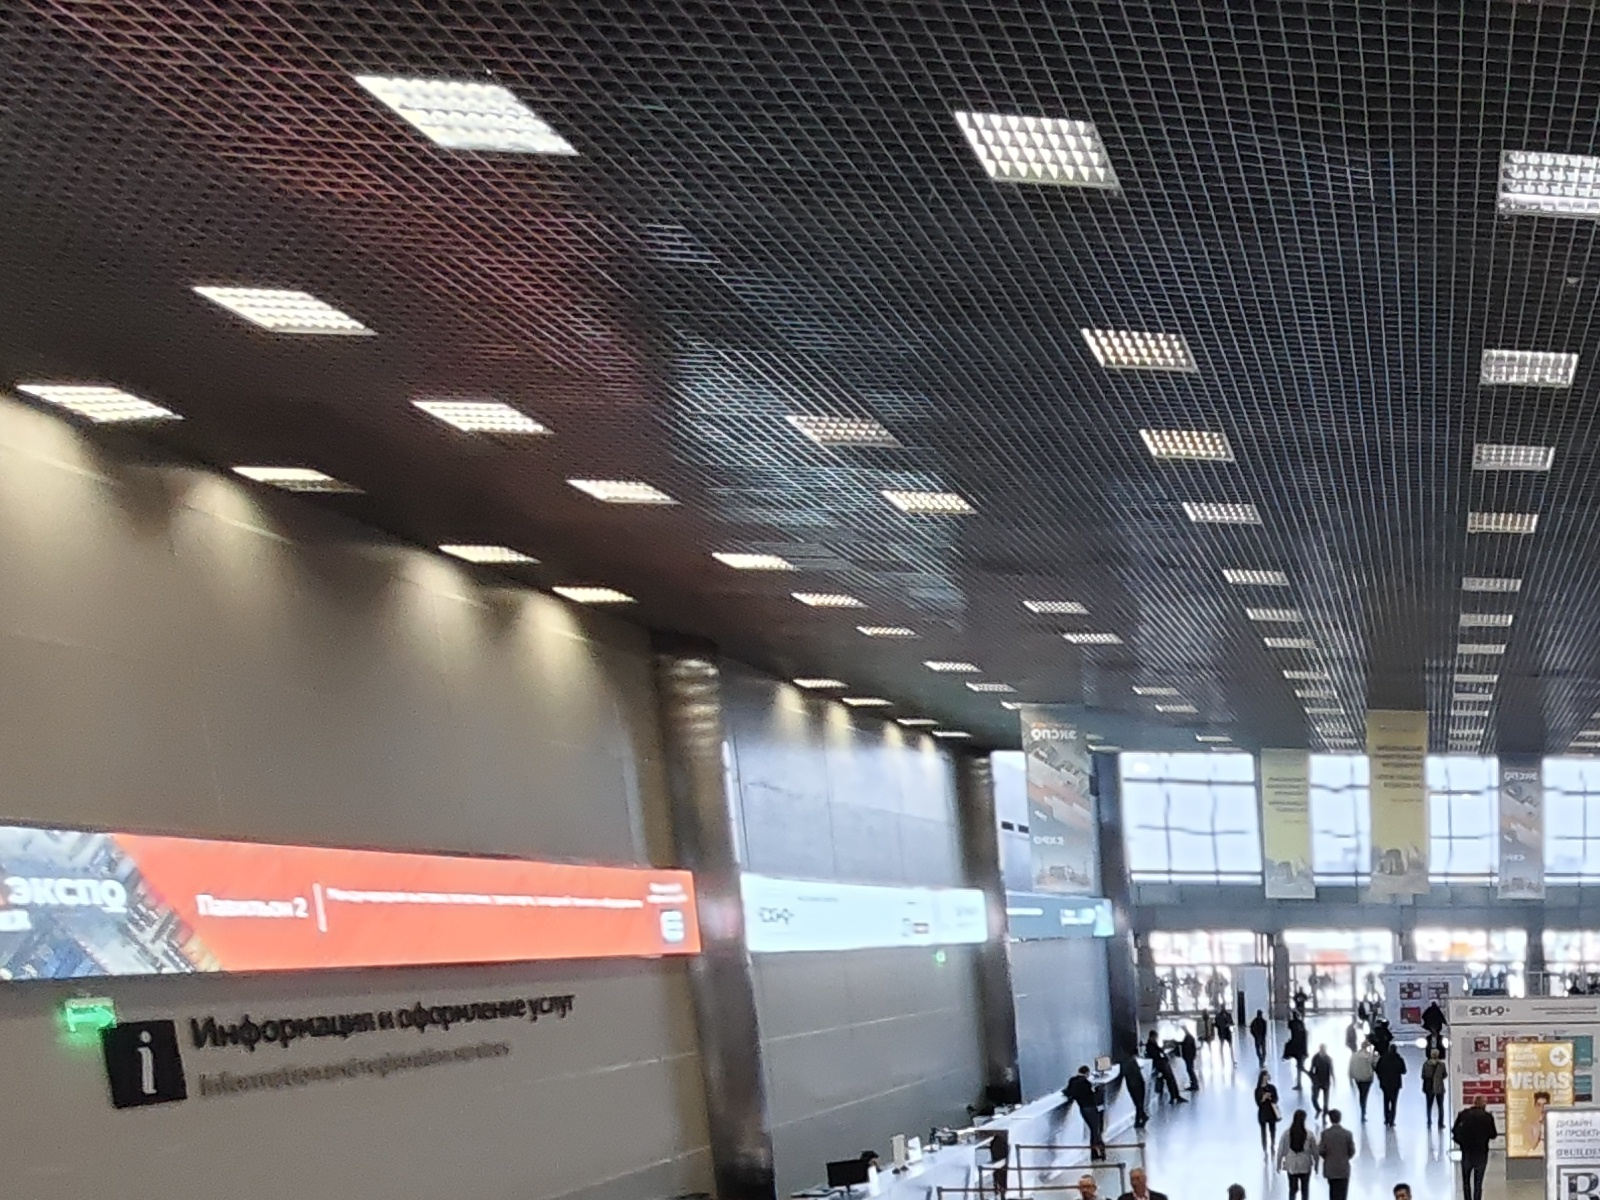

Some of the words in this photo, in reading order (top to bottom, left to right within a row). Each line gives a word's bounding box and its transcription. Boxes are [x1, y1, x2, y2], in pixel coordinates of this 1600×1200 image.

[4, 877, 127, 913] ЭКСПО
[293, 896, 309, 918] 2
[190, 1012, 376, 1053] Информация
[377, 1010, 394, 1030] и
[397, 998, 527, 1034] оформление
[1509, 1071, 1572, 1091] VEGAS
[1556, 1117, 1593, 1129] ДИЗАЙН
[1556, 1129, 1563, 1137] И
